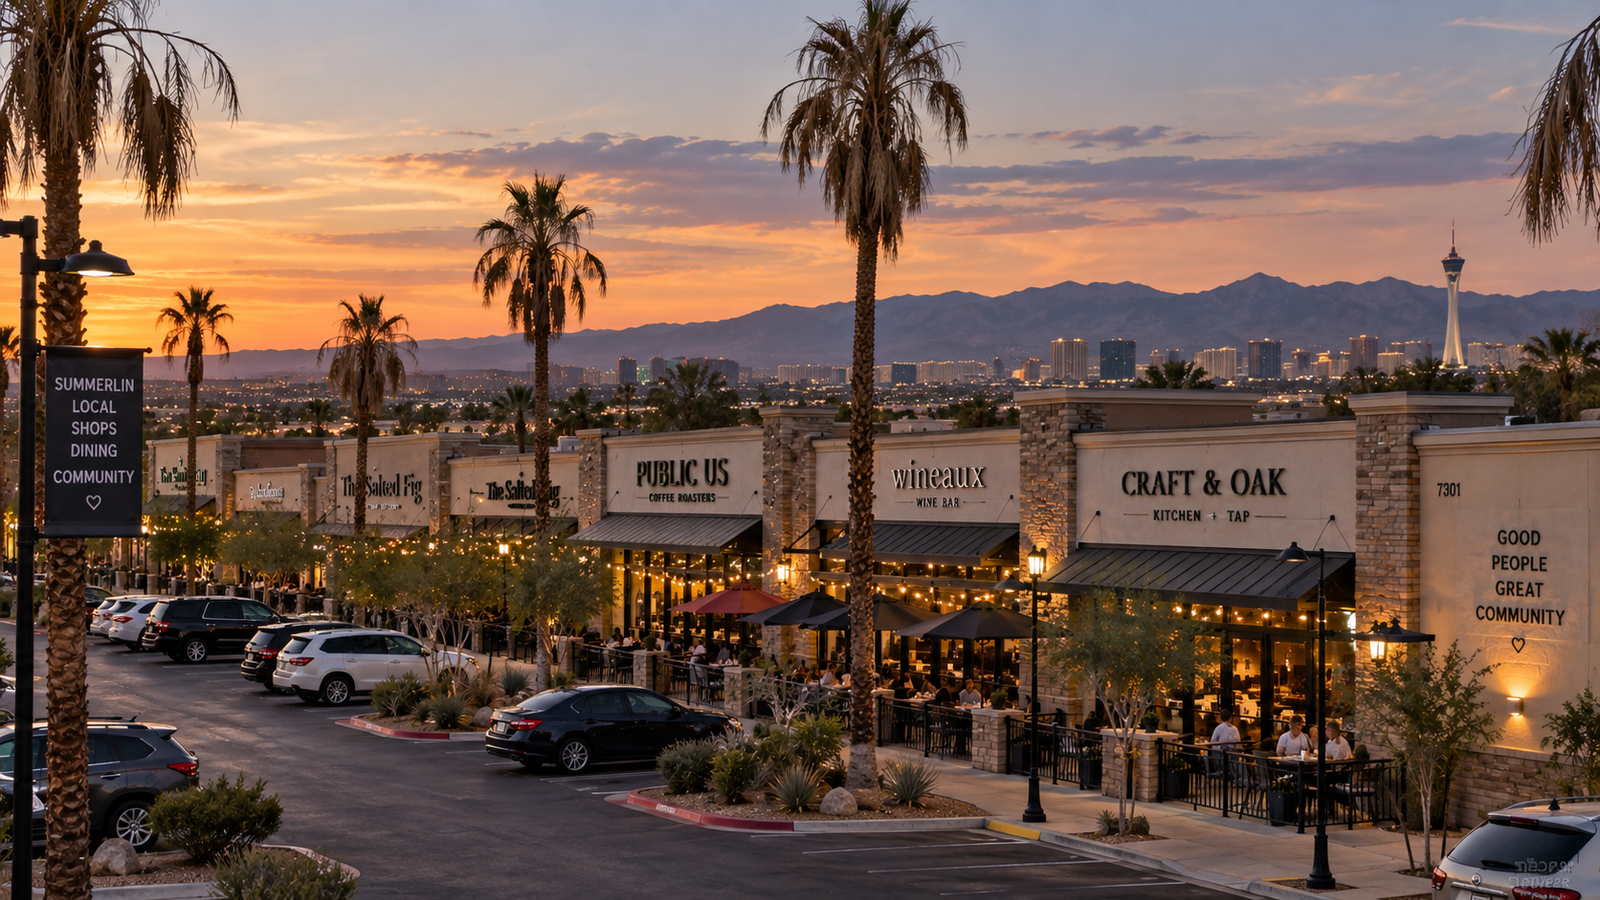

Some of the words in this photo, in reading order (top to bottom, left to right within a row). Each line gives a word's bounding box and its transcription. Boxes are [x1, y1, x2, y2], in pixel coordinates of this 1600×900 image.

[54, 377, 134, 392] SUMMERLIN
[72, 399, 117, 413] LOCAL
[71, 421, 117, 435] SHOPS
[70, 443, 117, 457] DINING
[53, 469, 135, 484] COMMUNITY
[636, 459, 698, 487] PUBLIC
[703, 457, 729, 486] US
[890, 459, 986, 489] wineaux
[341, 474, 355, 497] Th
[403, 473, 423, 505] Fig
[1121, 469, 1195, 496] CRAFT
[1202, 469, 1222, 496] &
[1230, 468, 1287, 496] OAK
[1437, 482, 1461, 497] 7301
[486, 481, 504, 500] The
[648, 493, 675, 502] COFFEE
[678, 493, 716, 502] ROASTERS
[916, 497, 938, 508] WINE
[942, 497, 960, 508] BAR
[1153, 509, 1201, 522] KITCHEN
[1227, 510, 1250, 522] TAP
[1497, 530, 1541, 546] GOOD
[1491, 555, 1547, 572] PEOPLE
[1495, 580, 1544, 598] GREAT
[1475, 605, 1565, 626] COMMUNITY
